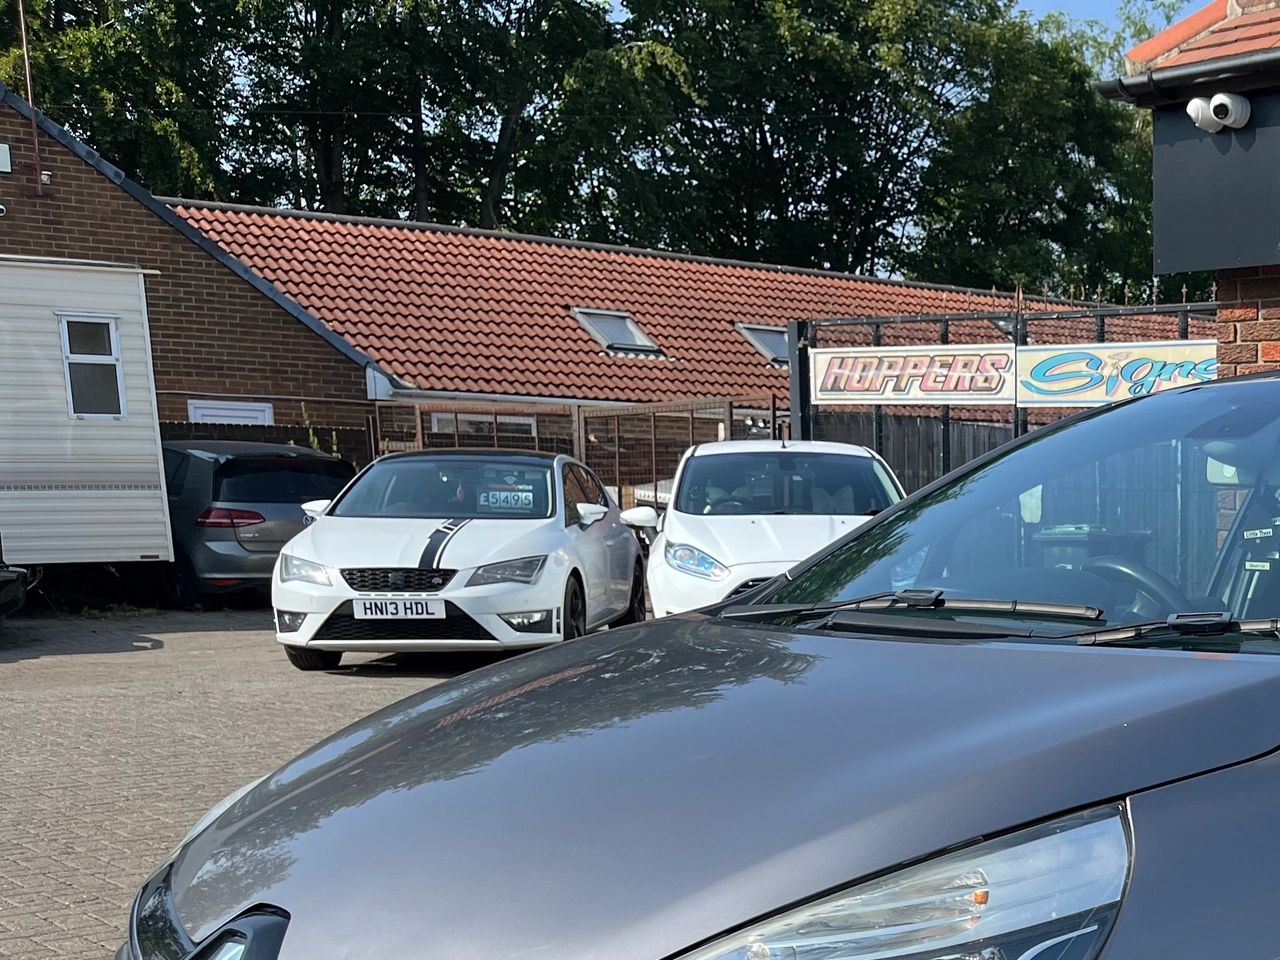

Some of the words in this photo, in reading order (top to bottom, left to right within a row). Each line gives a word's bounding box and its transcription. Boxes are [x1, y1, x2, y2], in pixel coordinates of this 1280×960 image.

[819, 353, 1013, 395] HOPPERS
[480, 491, 533, 507] £5495
[363, 602, 399, 615] HN13
[404, 602, 435, 615] HDL
